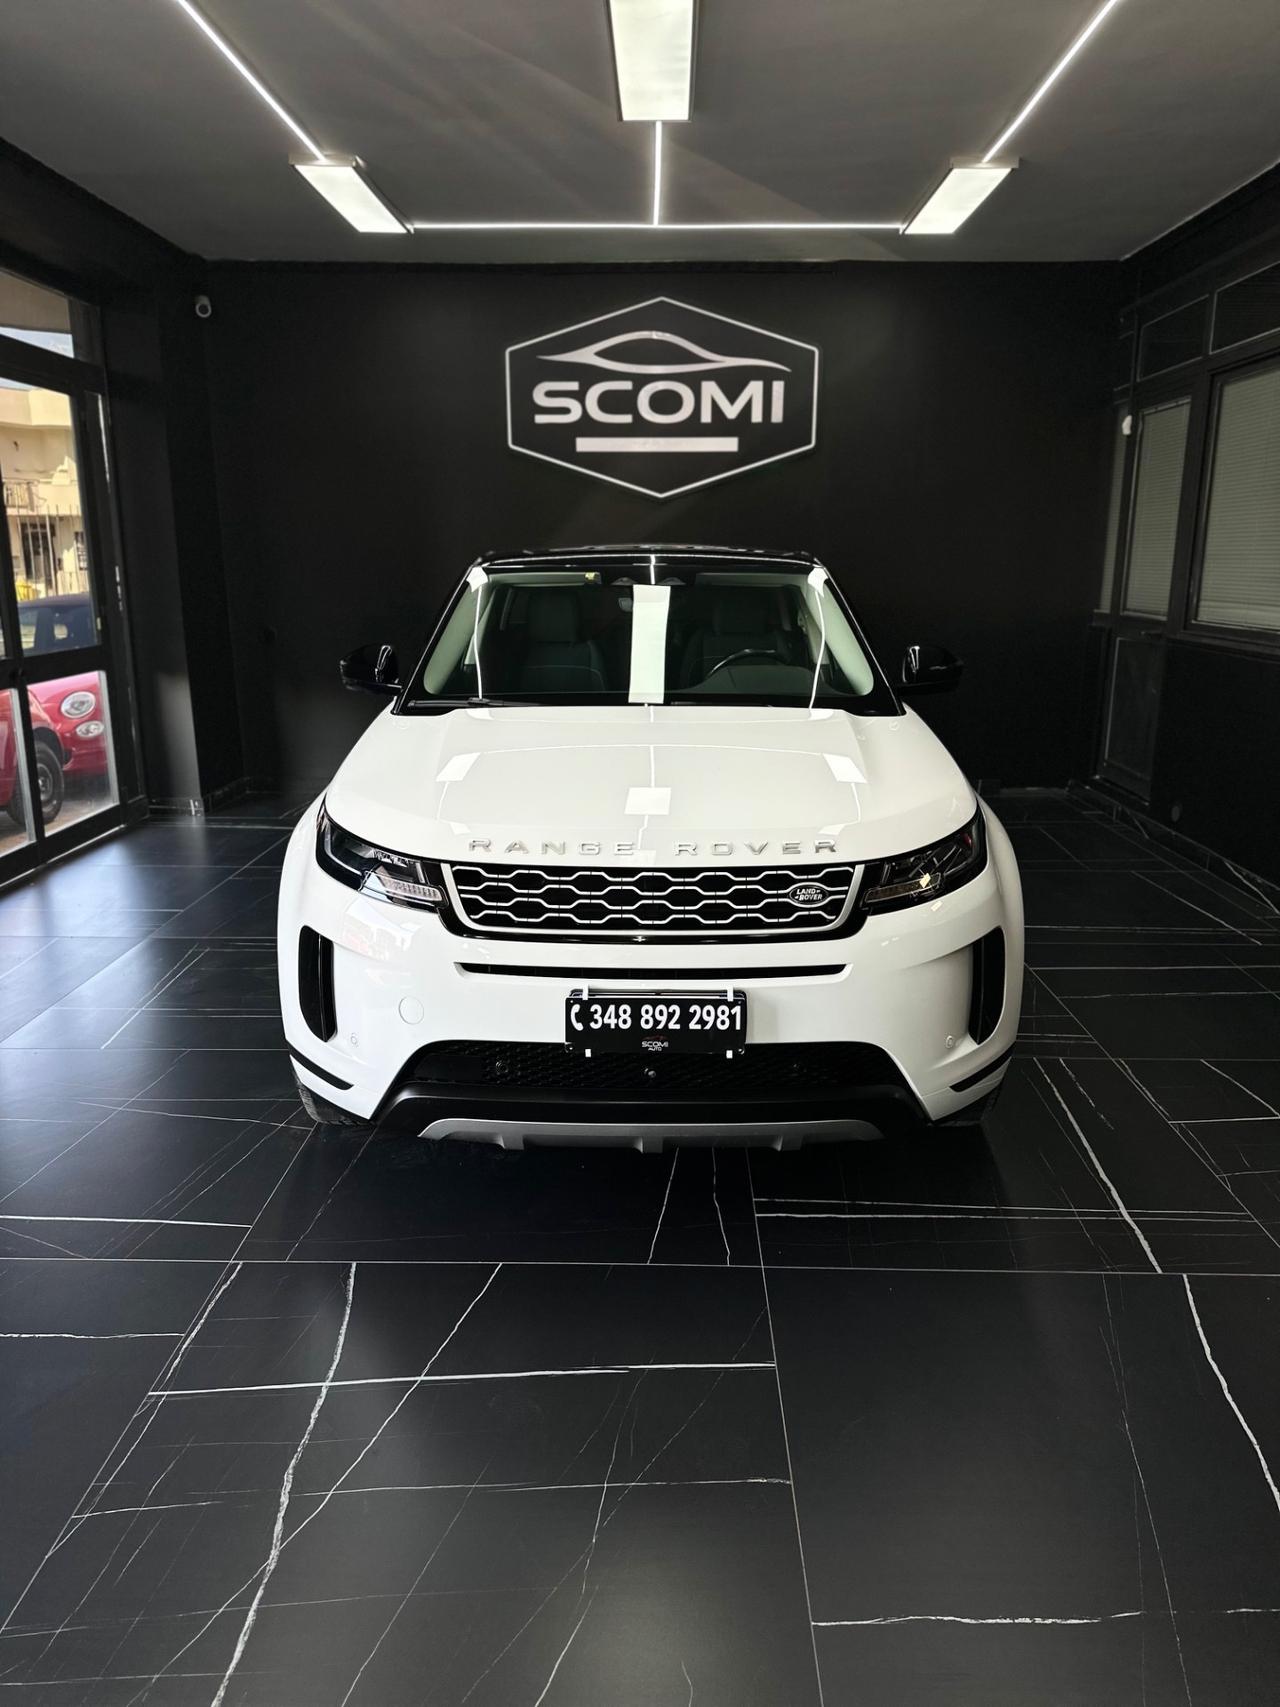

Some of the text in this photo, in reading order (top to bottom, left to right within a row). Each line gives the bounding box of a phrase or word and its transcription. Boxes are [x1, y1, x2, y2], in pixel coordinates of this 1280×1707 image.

[533, 380, 785, 424] SCOMI
[468, 839, 838, 857] RANGE ROVER
[799, 893, 823, 901] ROVER
[589, 1004, 741, 1030] 348 892 2981
[641, 1040, 669, 1048] SCOMI
